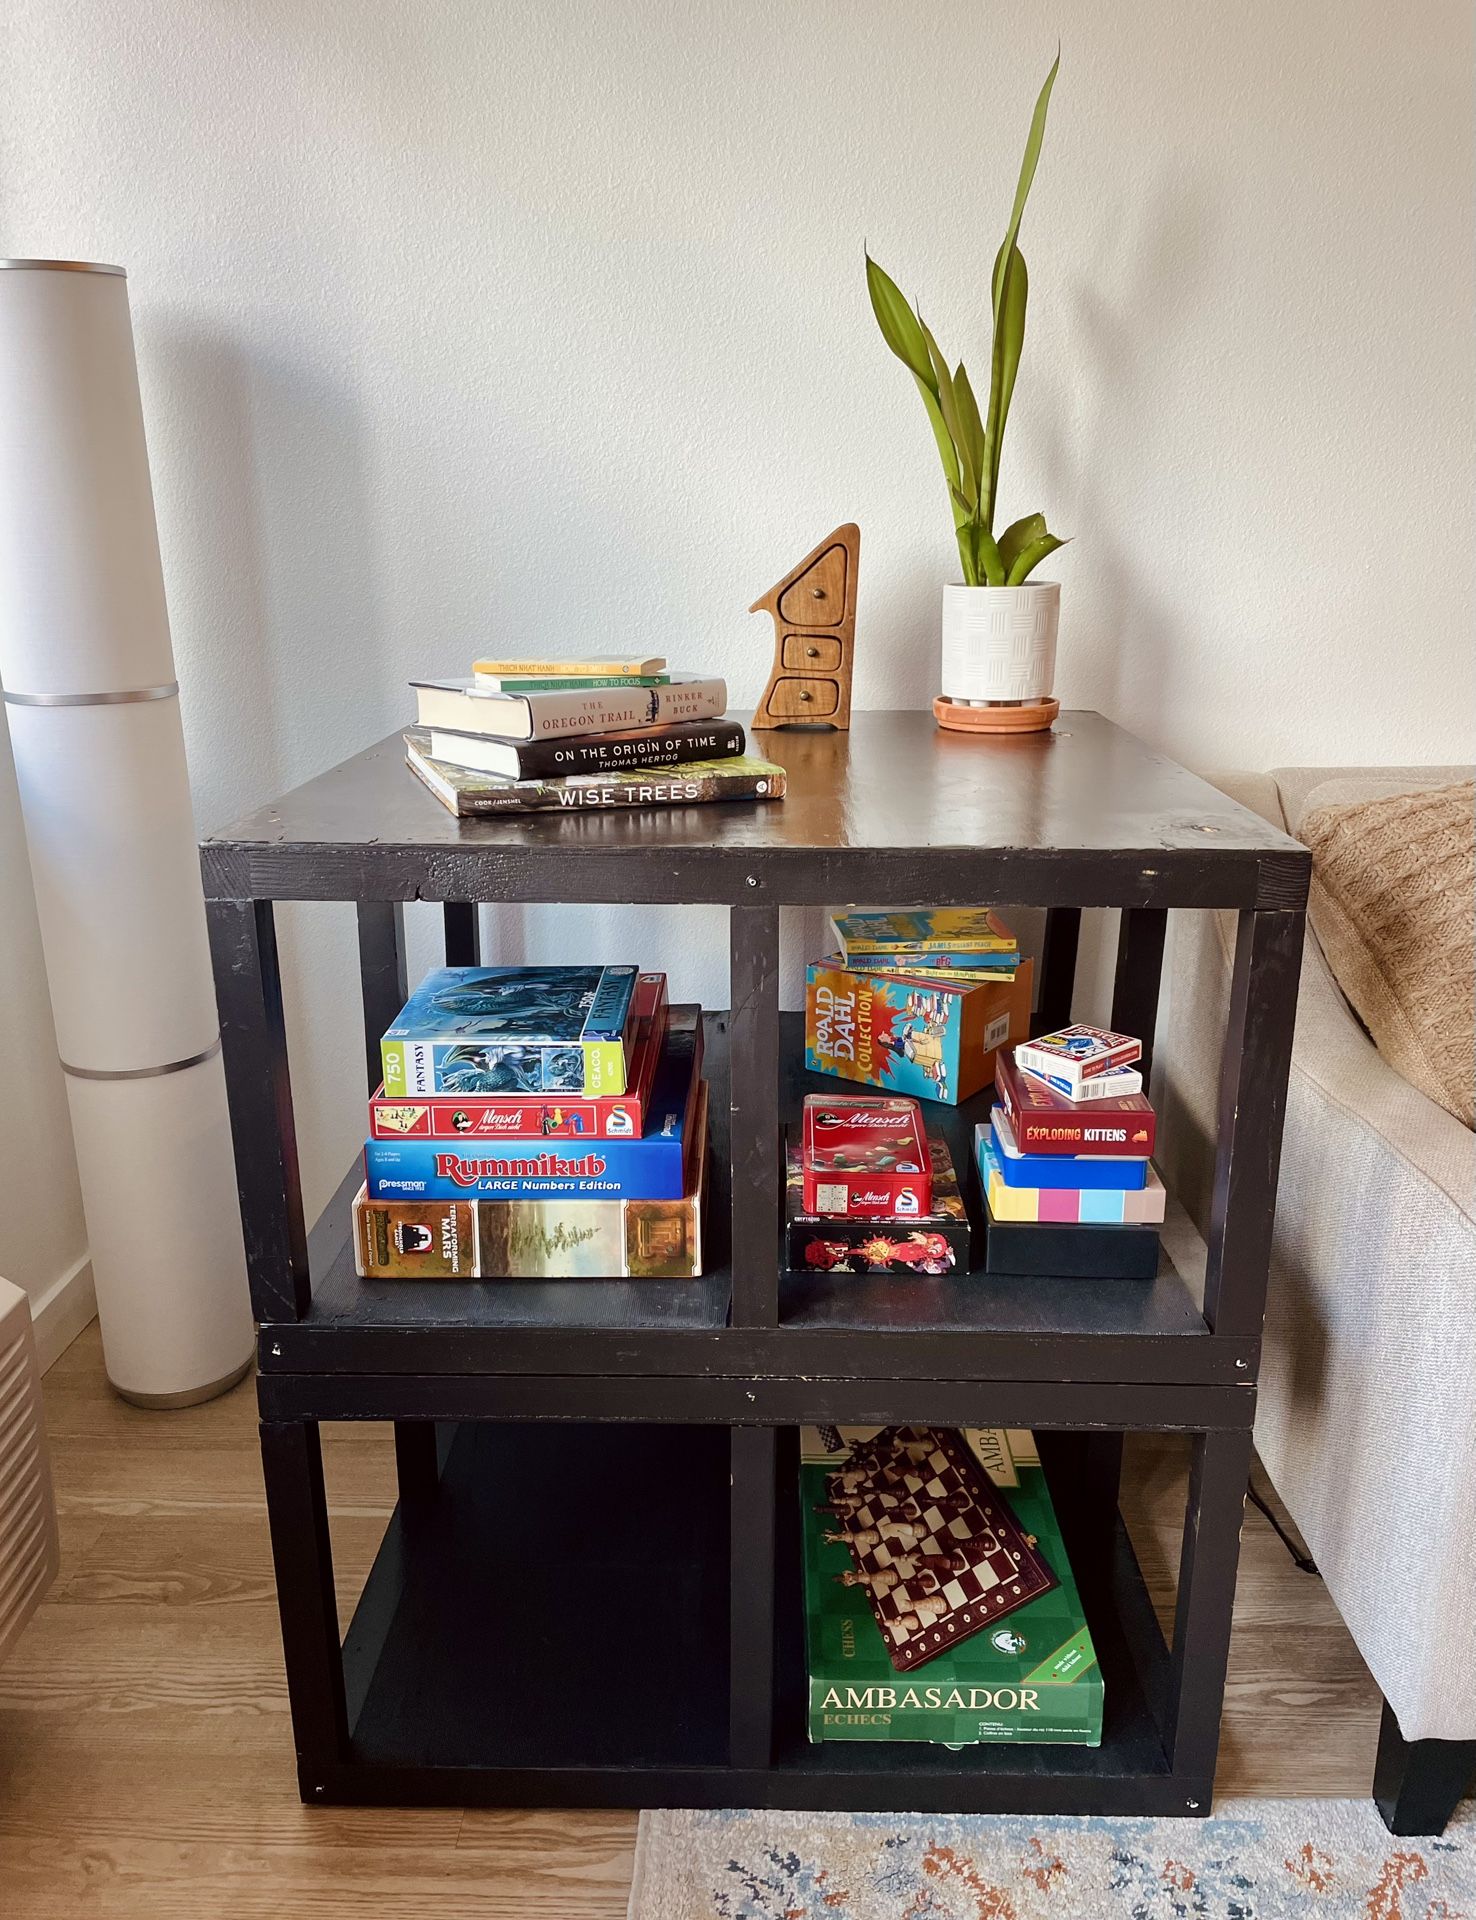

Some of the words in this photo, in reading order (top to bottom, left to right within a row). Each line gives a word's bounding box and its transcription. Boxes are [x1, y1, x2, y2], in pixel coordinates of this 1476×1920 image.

[610, 678, 619, 686] TO
[620, 677, 641, 686] FOCUS
[581, 701, 604, 711] THE
[665, 691, 704, 703] RINKER
[542, 714, 595, 730] OREGON
[600, 710, 636, 724] TRAIL
[673, 705, 699, 715] BUCK
[554, 750, 576, 762] ON
[581, 747, 608, 760] THE
[613, 738, 660, 757] ORIGIN
[665, 739, 682, 751] OF
[687, 736, 717, 748] TIME
[598, 757, 638, 769] THOMAS
[641, 753, 679, 764] HERTOG
[558, 788, 615, 806] WISE
[623, 783, 698, 803] TREES
[936, 955, 951, 965] BFG
[592, 980, 620, 1019] FANTASY
[815, 986, 835, 1057] ROALD
[833, 991, 856, 1061] DAHL
[856, 989, 873, 1073] COLLECTION
[1074, 1026, 1129, 1047] BICYCLE
[387, 1052, 401, 1085] 750
[416, 1044, 425, 1093] FANTASY
[481, 1109, 523, 1124] Mensch
[847, 1113, 911, 1124] Mensch
[1026, 1126, 1081, 1141] EXPLODING
[1084, 1128, 1127, 1141] KITTENS
[435, 1152, 606, 1187] Rummikub
[379, 1179, 425, 1191] pressman
[477, 1181, 518, 1190] LARGE
[522, 1180, 575, 1190] Numbers
[579, 1180, 621, 1190] Edition
[860, 1191, 890, 1202] Mensch
[440, 1218, 452, 1259] MARS
[449, 1204, 459, 1273] TERRAFORMING
[841, 1618, 856, 1658] CHESS
[820, 1686, 1041, 1711] AMBASADOR
[824, 1713, 892, 1726] ECHECS
